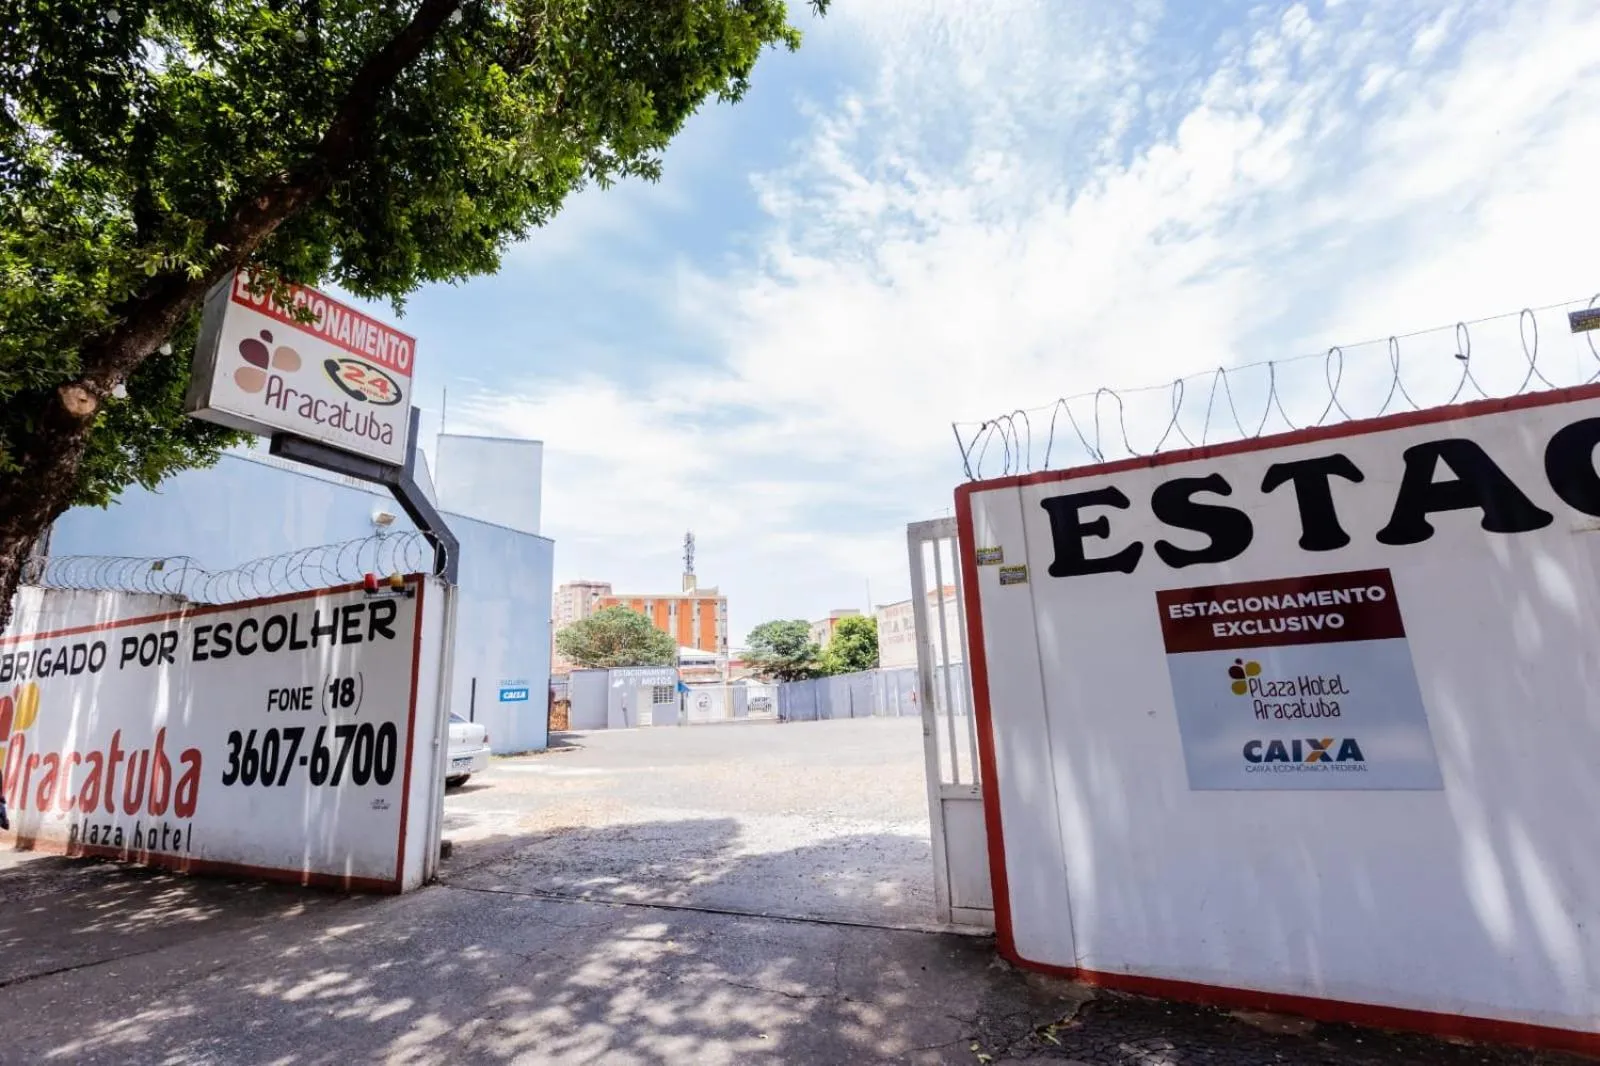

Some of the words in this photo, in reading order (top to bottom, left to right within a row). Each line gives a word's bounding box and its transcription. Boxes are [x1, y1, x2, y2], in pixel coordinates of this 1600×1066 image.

[344, 365, 389, 394] 24
[265, 375, 393, 445] Araçatuba
[1168, 585, 1386, 619] ESTACIONAMENTO
[120, 630, 178, 669] POR
[193, 599, 397, 662] ESCOLHER
[1213, 612, 1345, 638] EXCLUSIVO
[267, 686, 314, 712] FONE
[322, 671, 364, 716] (18)
[1254, 700, 1341, 721] Araçatuba
[221, 721, 398, 787] 3607-6700
[1243, 737, 1365, 763] CAIXA
[70, 817, 124, 849] plaza
[133, 820, 192, 852] hotel
